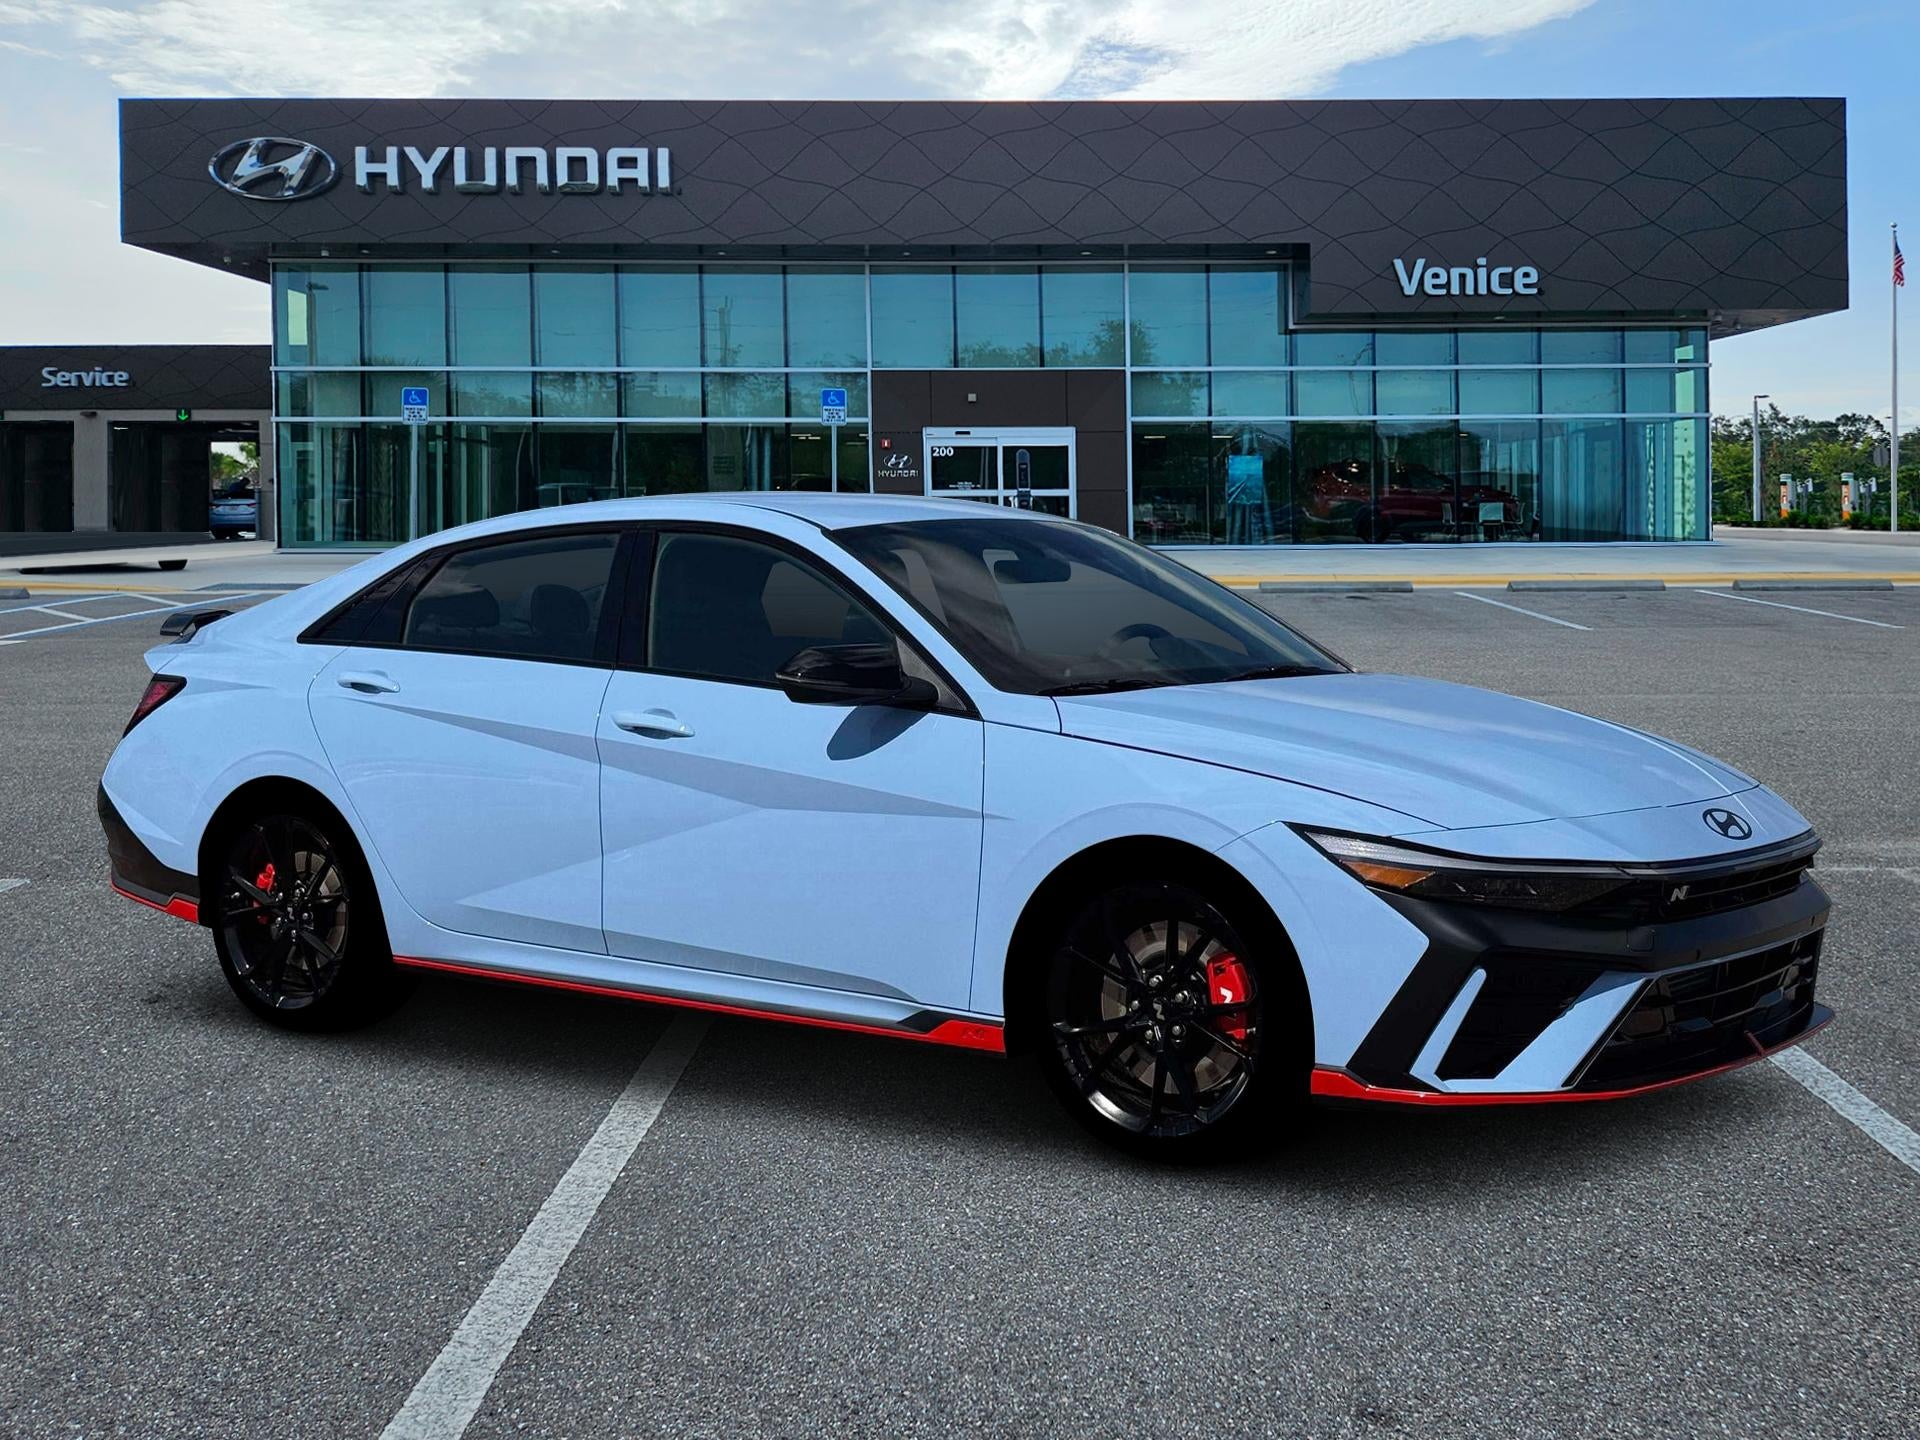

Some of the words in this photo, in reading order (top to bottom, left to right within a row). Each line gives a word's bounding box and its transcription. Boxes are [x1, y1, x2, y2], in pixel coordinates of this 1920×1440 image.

[354, 146, 672, 194] HYUNDAI
[1392, 256, 1539, 296] Venice
[41, 366, 130, 388] Service
[932, 446, 955, 458] 200
[877, 469, 919, 478] HYUNDAI
